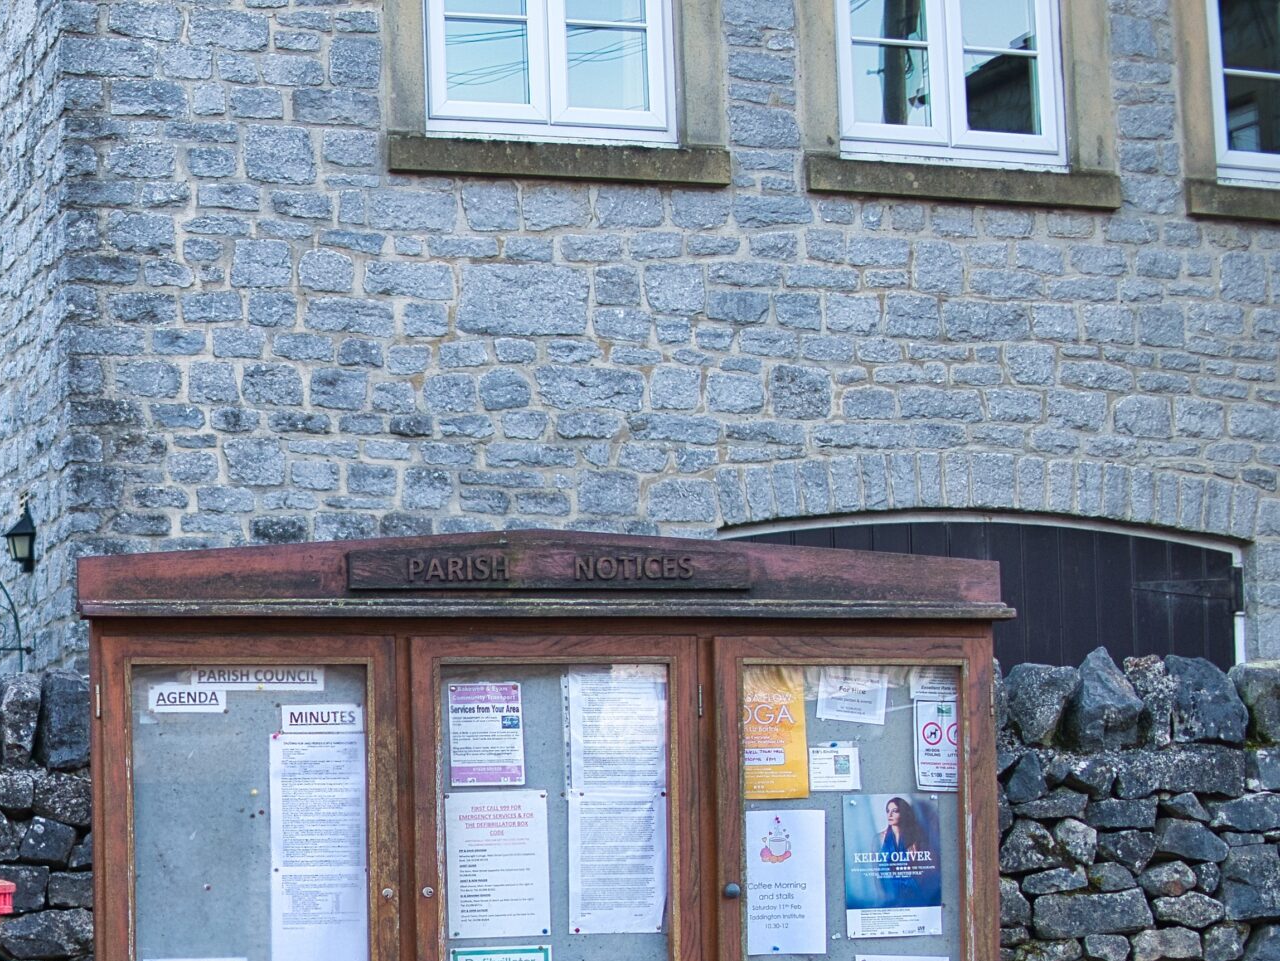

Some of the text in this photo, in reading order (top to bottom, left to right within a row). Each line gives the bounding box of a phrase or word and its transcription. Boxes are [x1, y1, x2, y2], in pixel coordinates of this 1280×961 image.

[407, 556, 694, 582] PARISH NOTICES
[197, 669, 318, 682] PARISH COUNCIL
[156, 691, 219, 704] AGENDA
[851, 687, 867, 695] Hire
[450, 704, 520, 714] Services from Your Area
[289, 710, 356, 724] MINUTES
[853, 850, 932, 863] KELLY OLIVER
[774, 882, 807, 890] Morning
